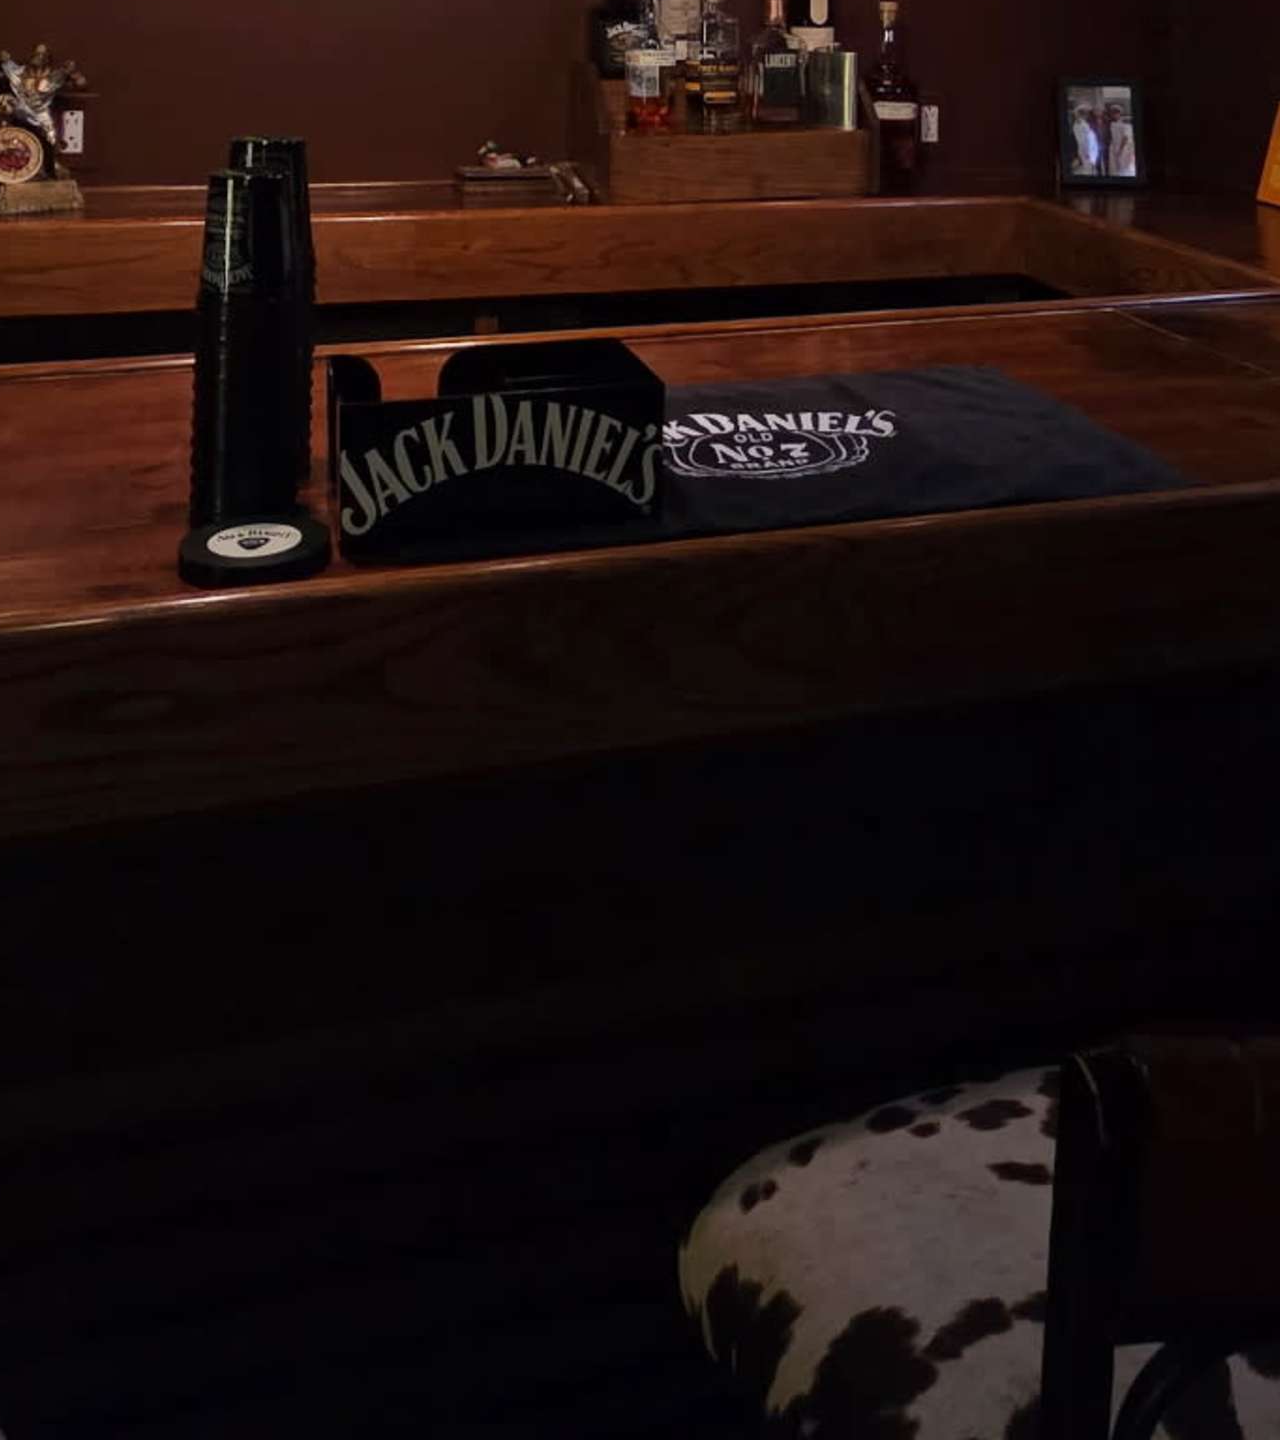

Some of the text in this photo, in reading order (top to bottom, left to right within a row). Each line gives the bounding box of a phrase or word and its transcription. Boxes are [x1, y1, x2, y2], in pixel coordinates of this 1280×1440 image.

[687, 409, 897, 437] DANIEL'S
[733, 432, 774, 444] OLD
[339, 392, 663, 536] JACK DANIEL'S
